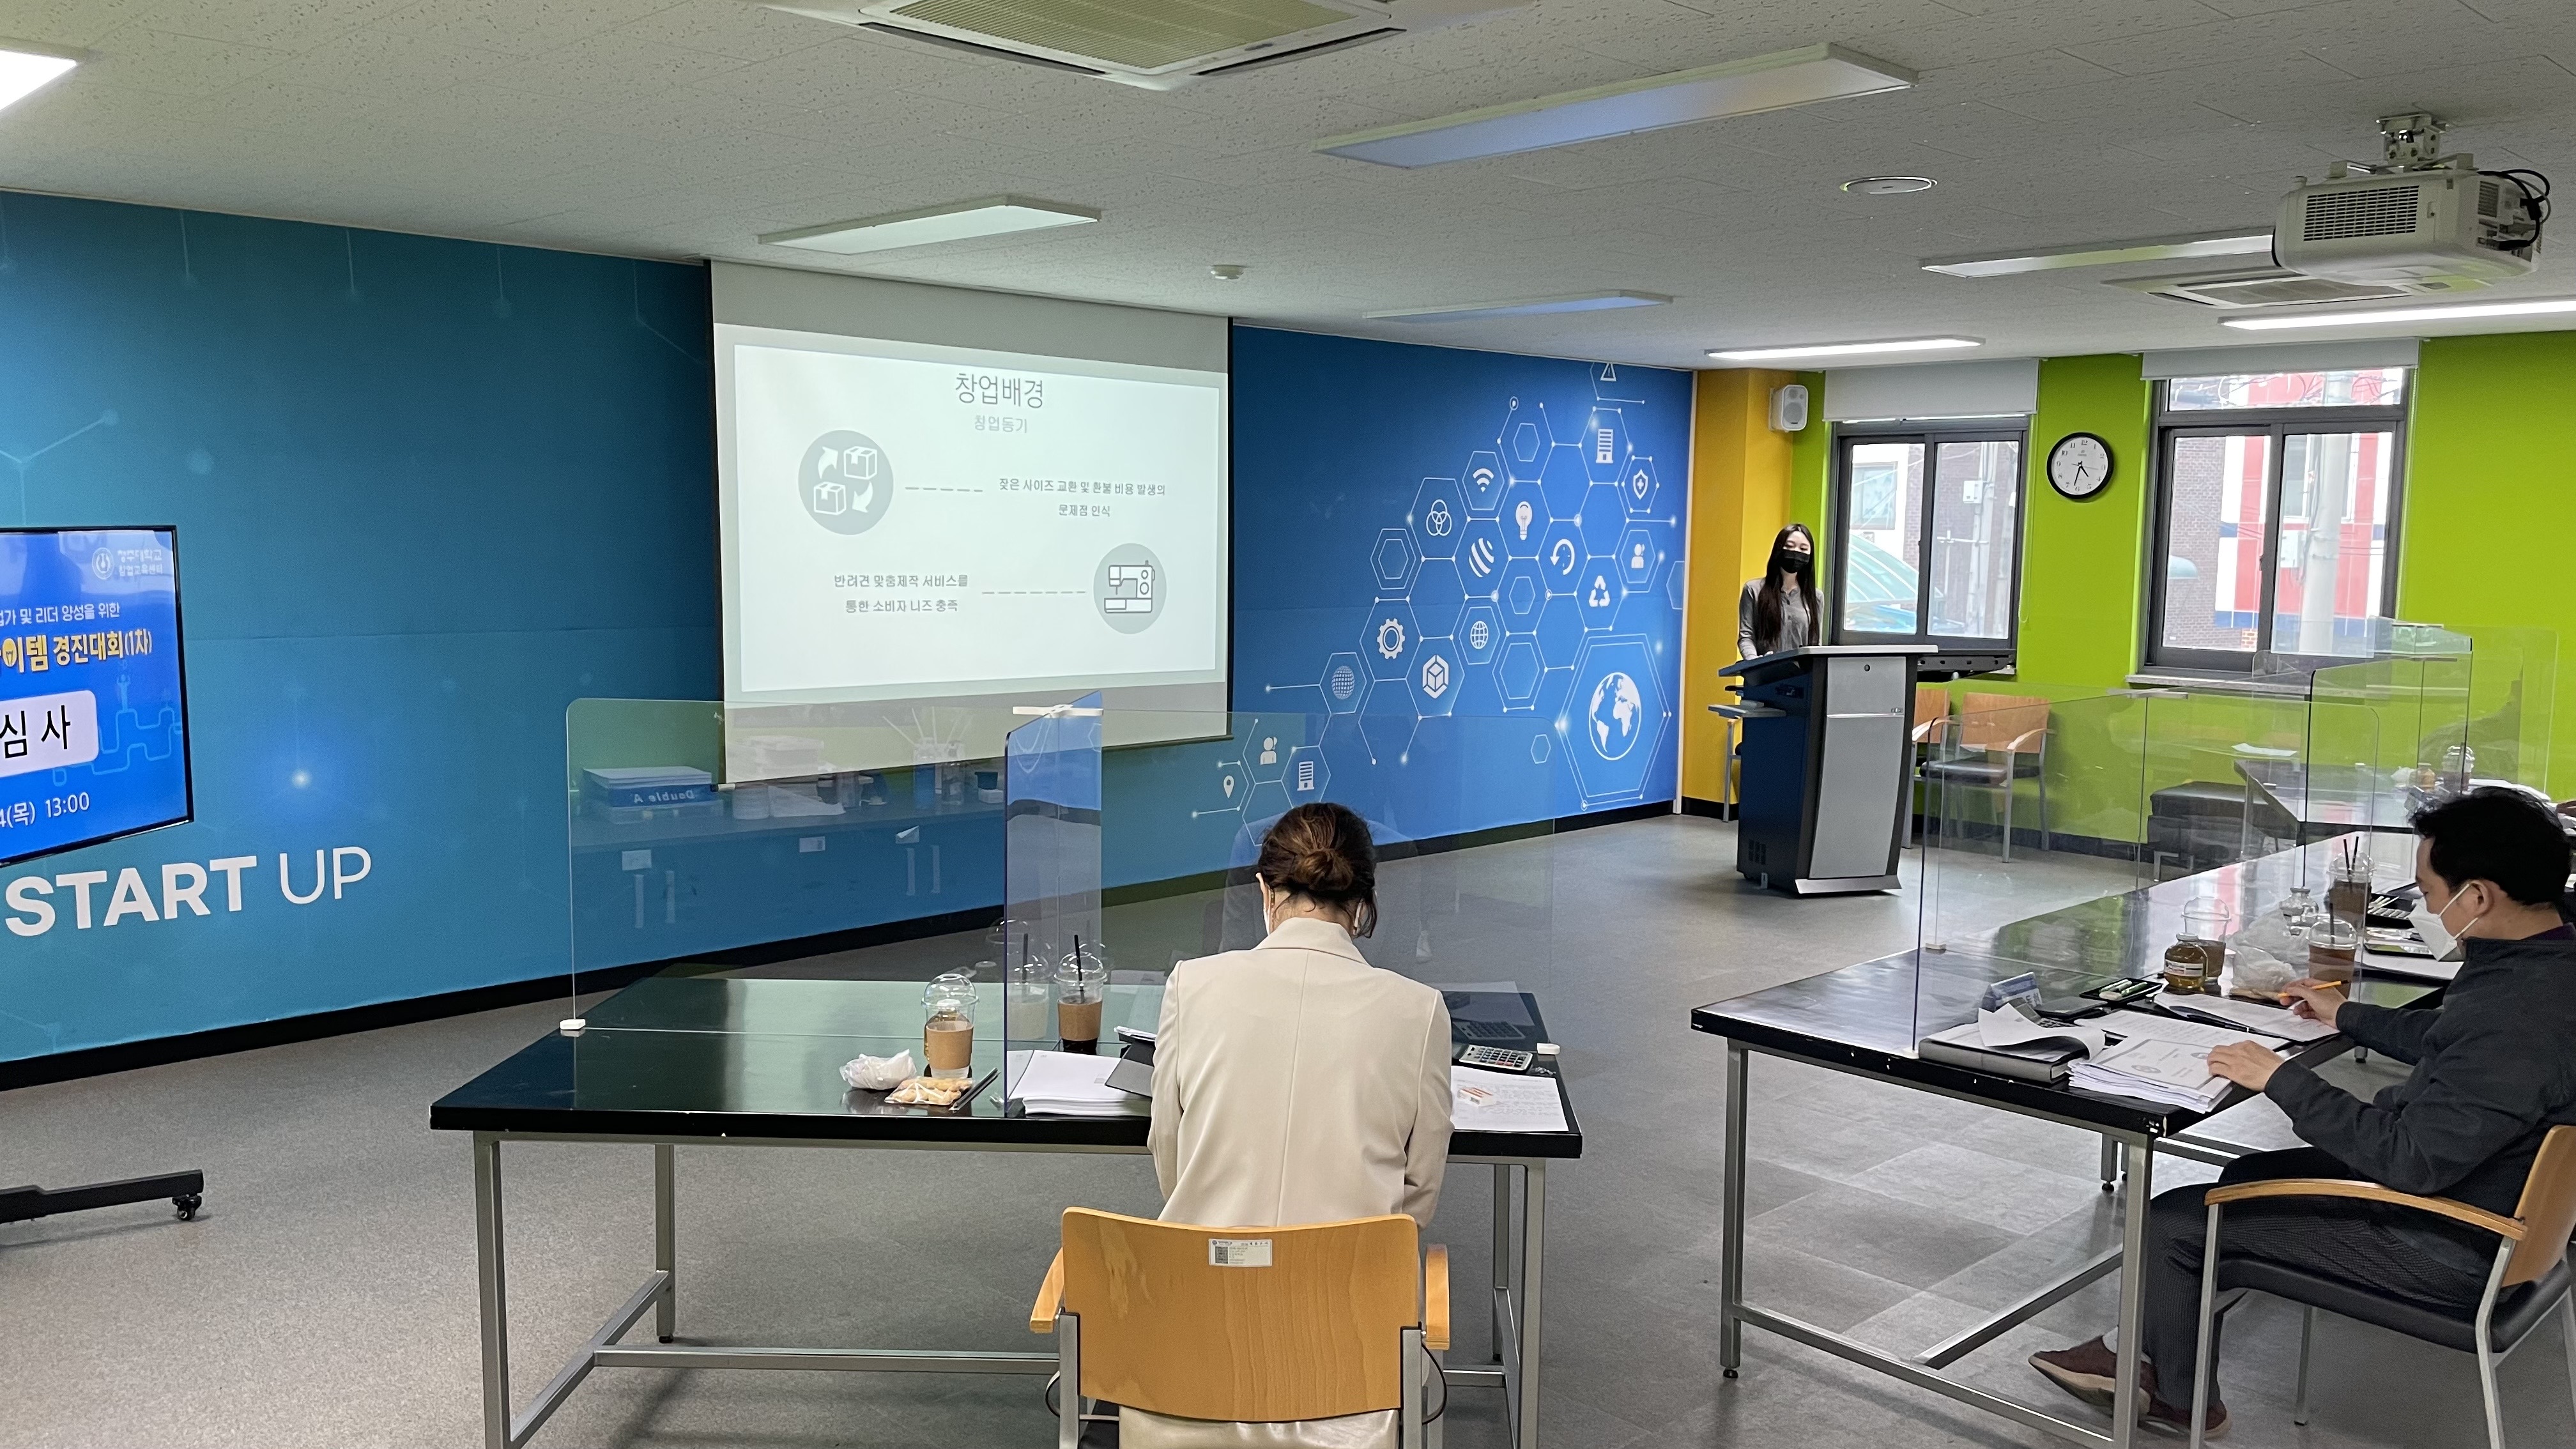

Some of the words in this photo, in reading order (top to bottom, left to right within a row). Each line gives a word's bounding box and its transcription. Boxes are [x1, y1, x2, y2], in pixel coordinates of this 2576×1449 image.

[956, 373, 1043, 408] 창업배경
[974, 415, 1027, 434] 창업동기
[1023, 479, 1054, 492] 사이즈
[1057, 480, 1077, 493] 교환
[1080, 482, 1090, 493] 및
[1092, 482, 1112, 494] 환불
[1115, 484, 1134, 495] 비용
[1137, 484, 1166, 496] 발생의
[1059, 504, 1088, 517] 문제점
[1091, 505, 1110, 517] 인식
[834, 574, 870, 588] 반려견
[873, 574, 919, 588] 맞춤제작
[923, 574, 968, 588] 서비스를
[20, 608, 32, 625] 및
[35, 606, 59, 624] 리더
[61, 603, 95, 622] 양성을
[98, 602, 120, 618] 위한
[845, 599, 869, 613] 통한
[873, 599, 907, 612] 소비자
[910, 599, 932, 611] 니즈
[935, 599, 958, 612] 충족
[0, 634, 49, 673] 이템
[0, 710, 27, 759] 심
[41, 705, 71, 749] 사
[45, 792, 89, 818] 13:00
[4, 855, 257, 937] START
[279, 847, 372, 904] UP
